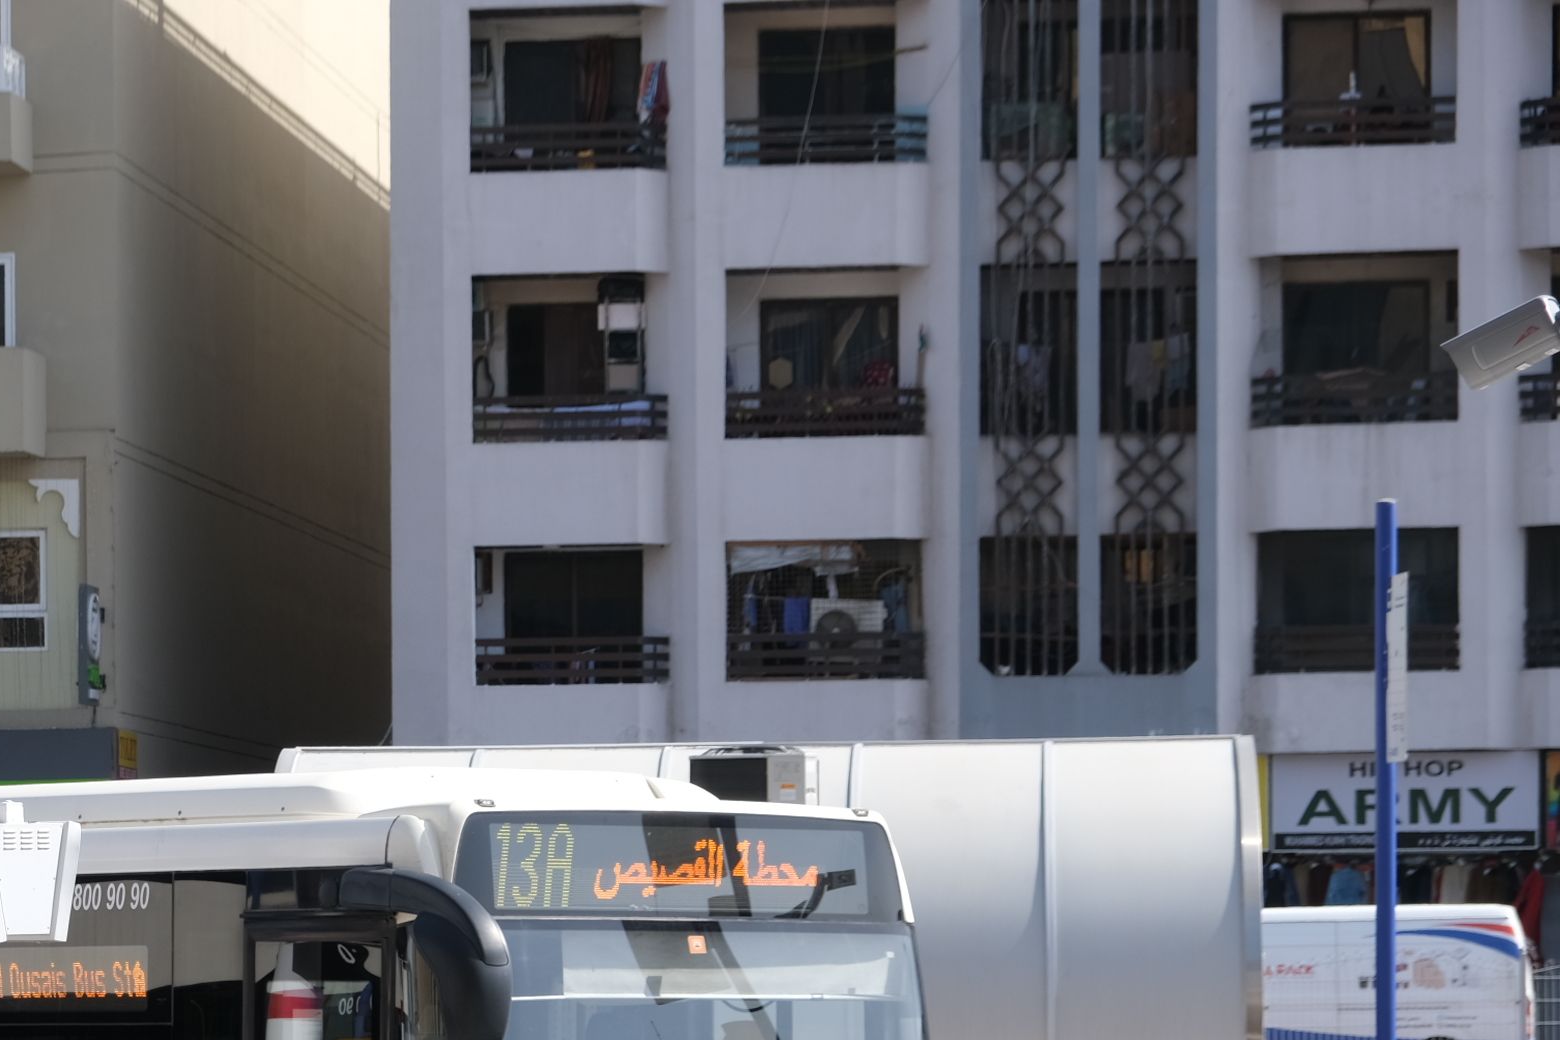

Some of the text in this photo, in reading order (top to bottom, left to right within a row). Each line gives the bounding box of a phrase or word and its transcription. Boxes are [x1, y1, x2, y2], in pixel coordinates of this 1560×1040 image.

[1404, 760, 1462, 777] HOP
[496, 823, 574, 907] 13A
[594, 840, 818, 899] محطة القصيص
[73, 882, 149, 910] 800 90 90
[73, 962, 106, 997] Bus
